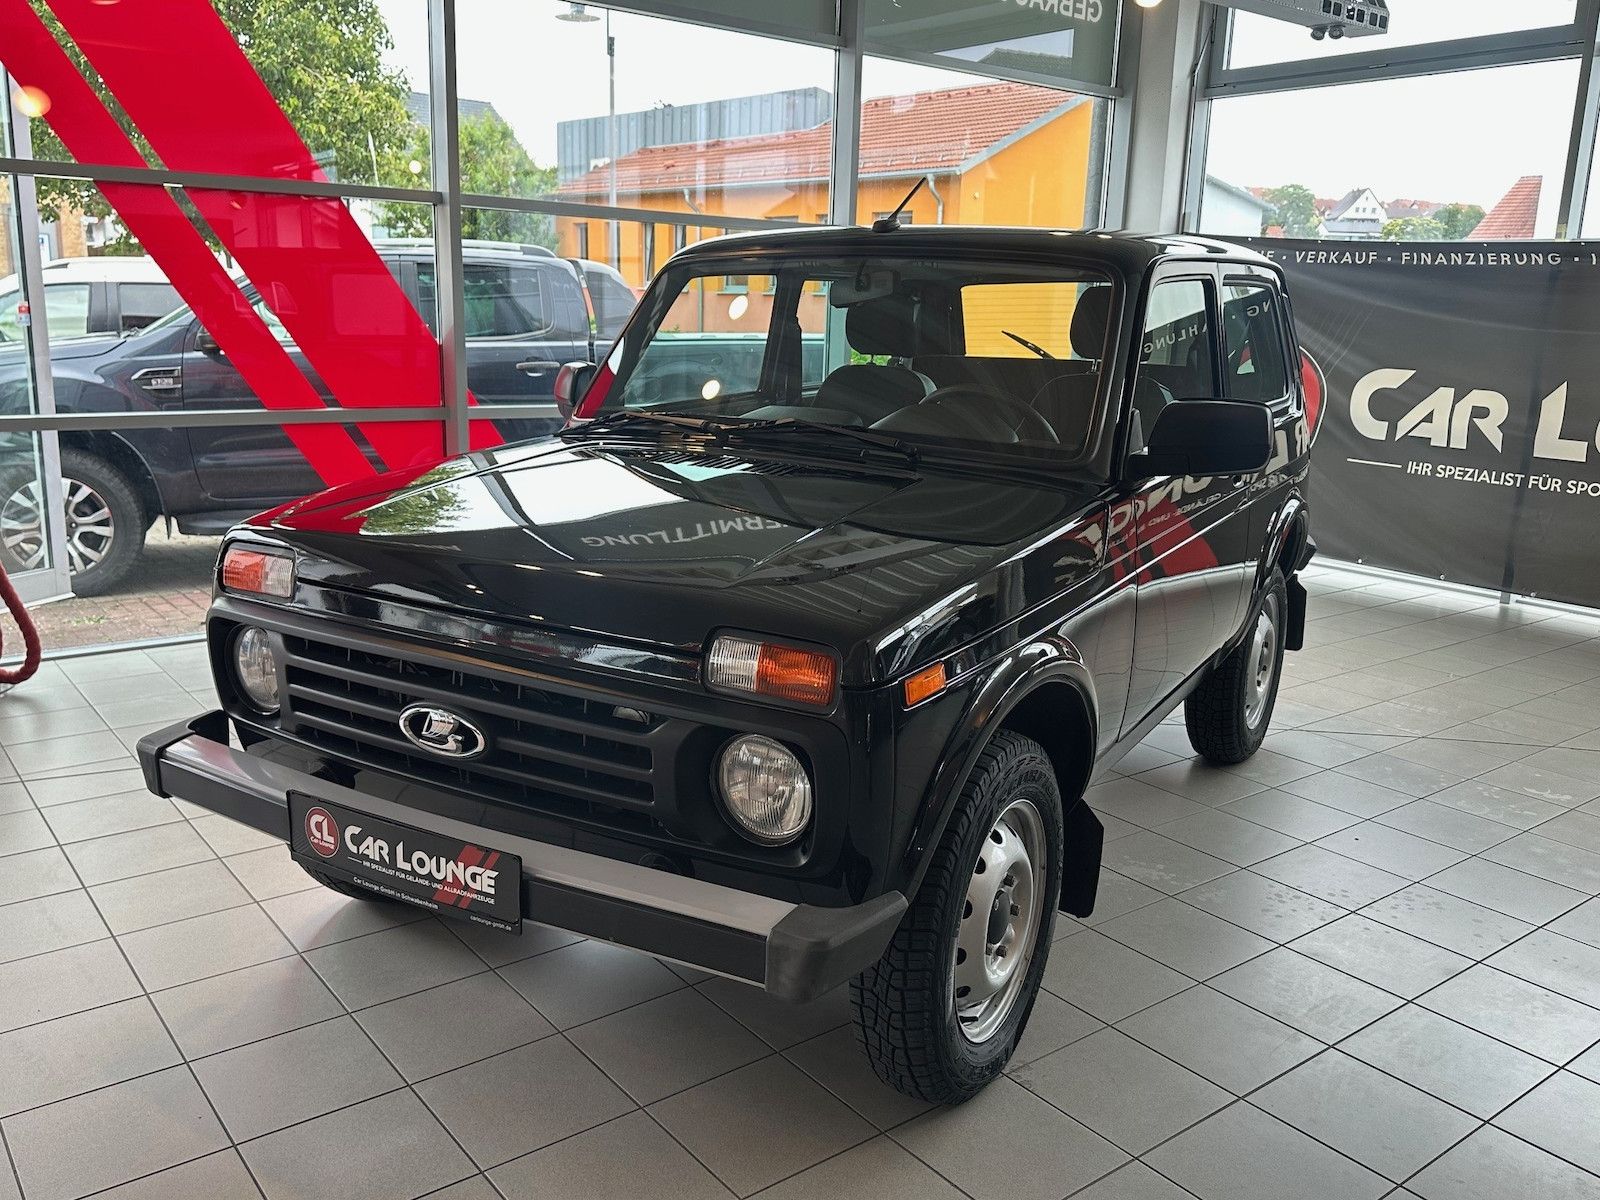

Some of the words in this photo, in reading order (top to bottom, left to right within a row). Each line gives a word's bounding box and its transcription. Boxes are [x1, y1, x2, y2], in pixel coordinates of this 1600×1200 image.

[1295, 251, 1378, 265] VERKAUF
[1401, 252, 1562, 266] FINANZIERUNG
[1350, 368, 1509, 454] CAR
[1533, 381, 1600, 463] L
[1406, 461, 1433, 476] IHR
[1436, 465, 1525, 488] SPEZIALIST
[1528, 474, 1561, 492] FÜR
[309, 814, 335, 843] CL
[344, 825, 390, 864] CAR
[396, 841, 499, 895] LOUNGE
[362, 879, 380, 891] Lounge
[371, 863, 395, 876] SPEZIALIST
[431, 881, 443, 891] UND
[443, 885, 495, 905] ALLRADFAHRZEUGE
